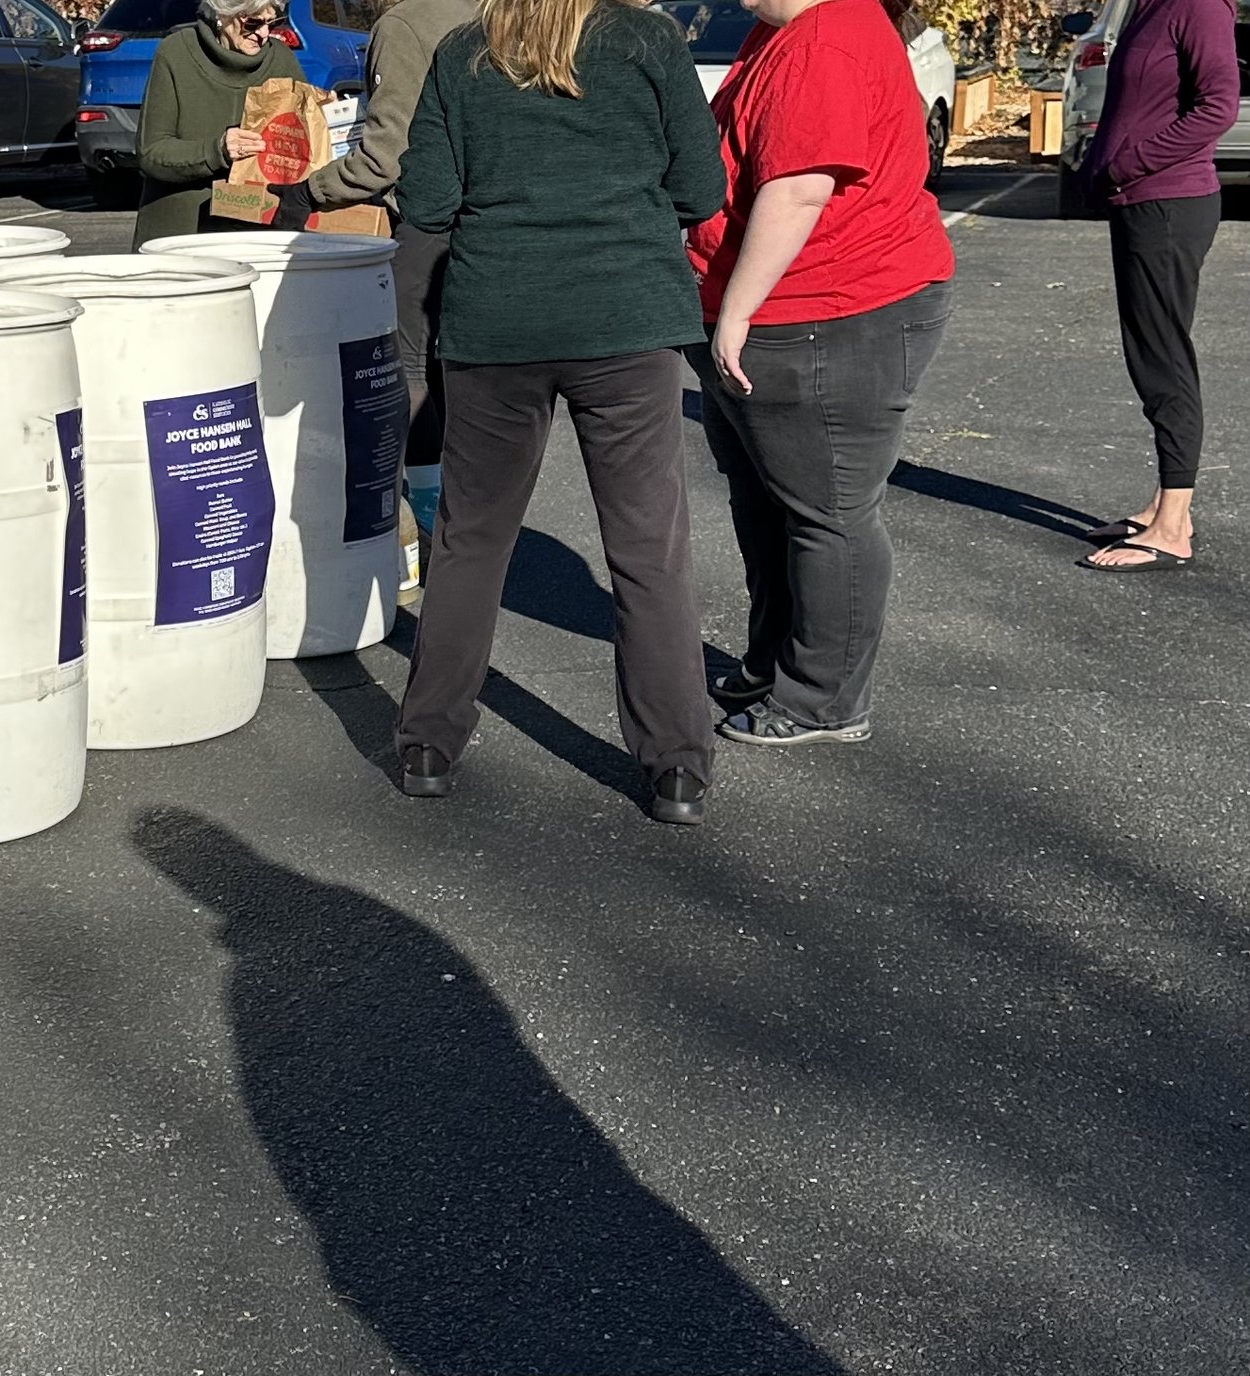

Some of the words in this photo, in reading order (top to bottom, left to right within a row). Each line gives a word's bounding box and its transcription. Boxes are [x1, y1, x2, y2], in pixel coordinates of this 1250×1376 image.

[265, 154, 301, 171] PRICES
[354, 367, 377, 380] JOYCE
[165, 428, 200, 444] JOYCE
[200, 420, 236, 438] HANSEN
[236, 417, 253, 431] HALL
[190, 439, 218, 454] FOOD
[219, 434, 242, 449] BANK
